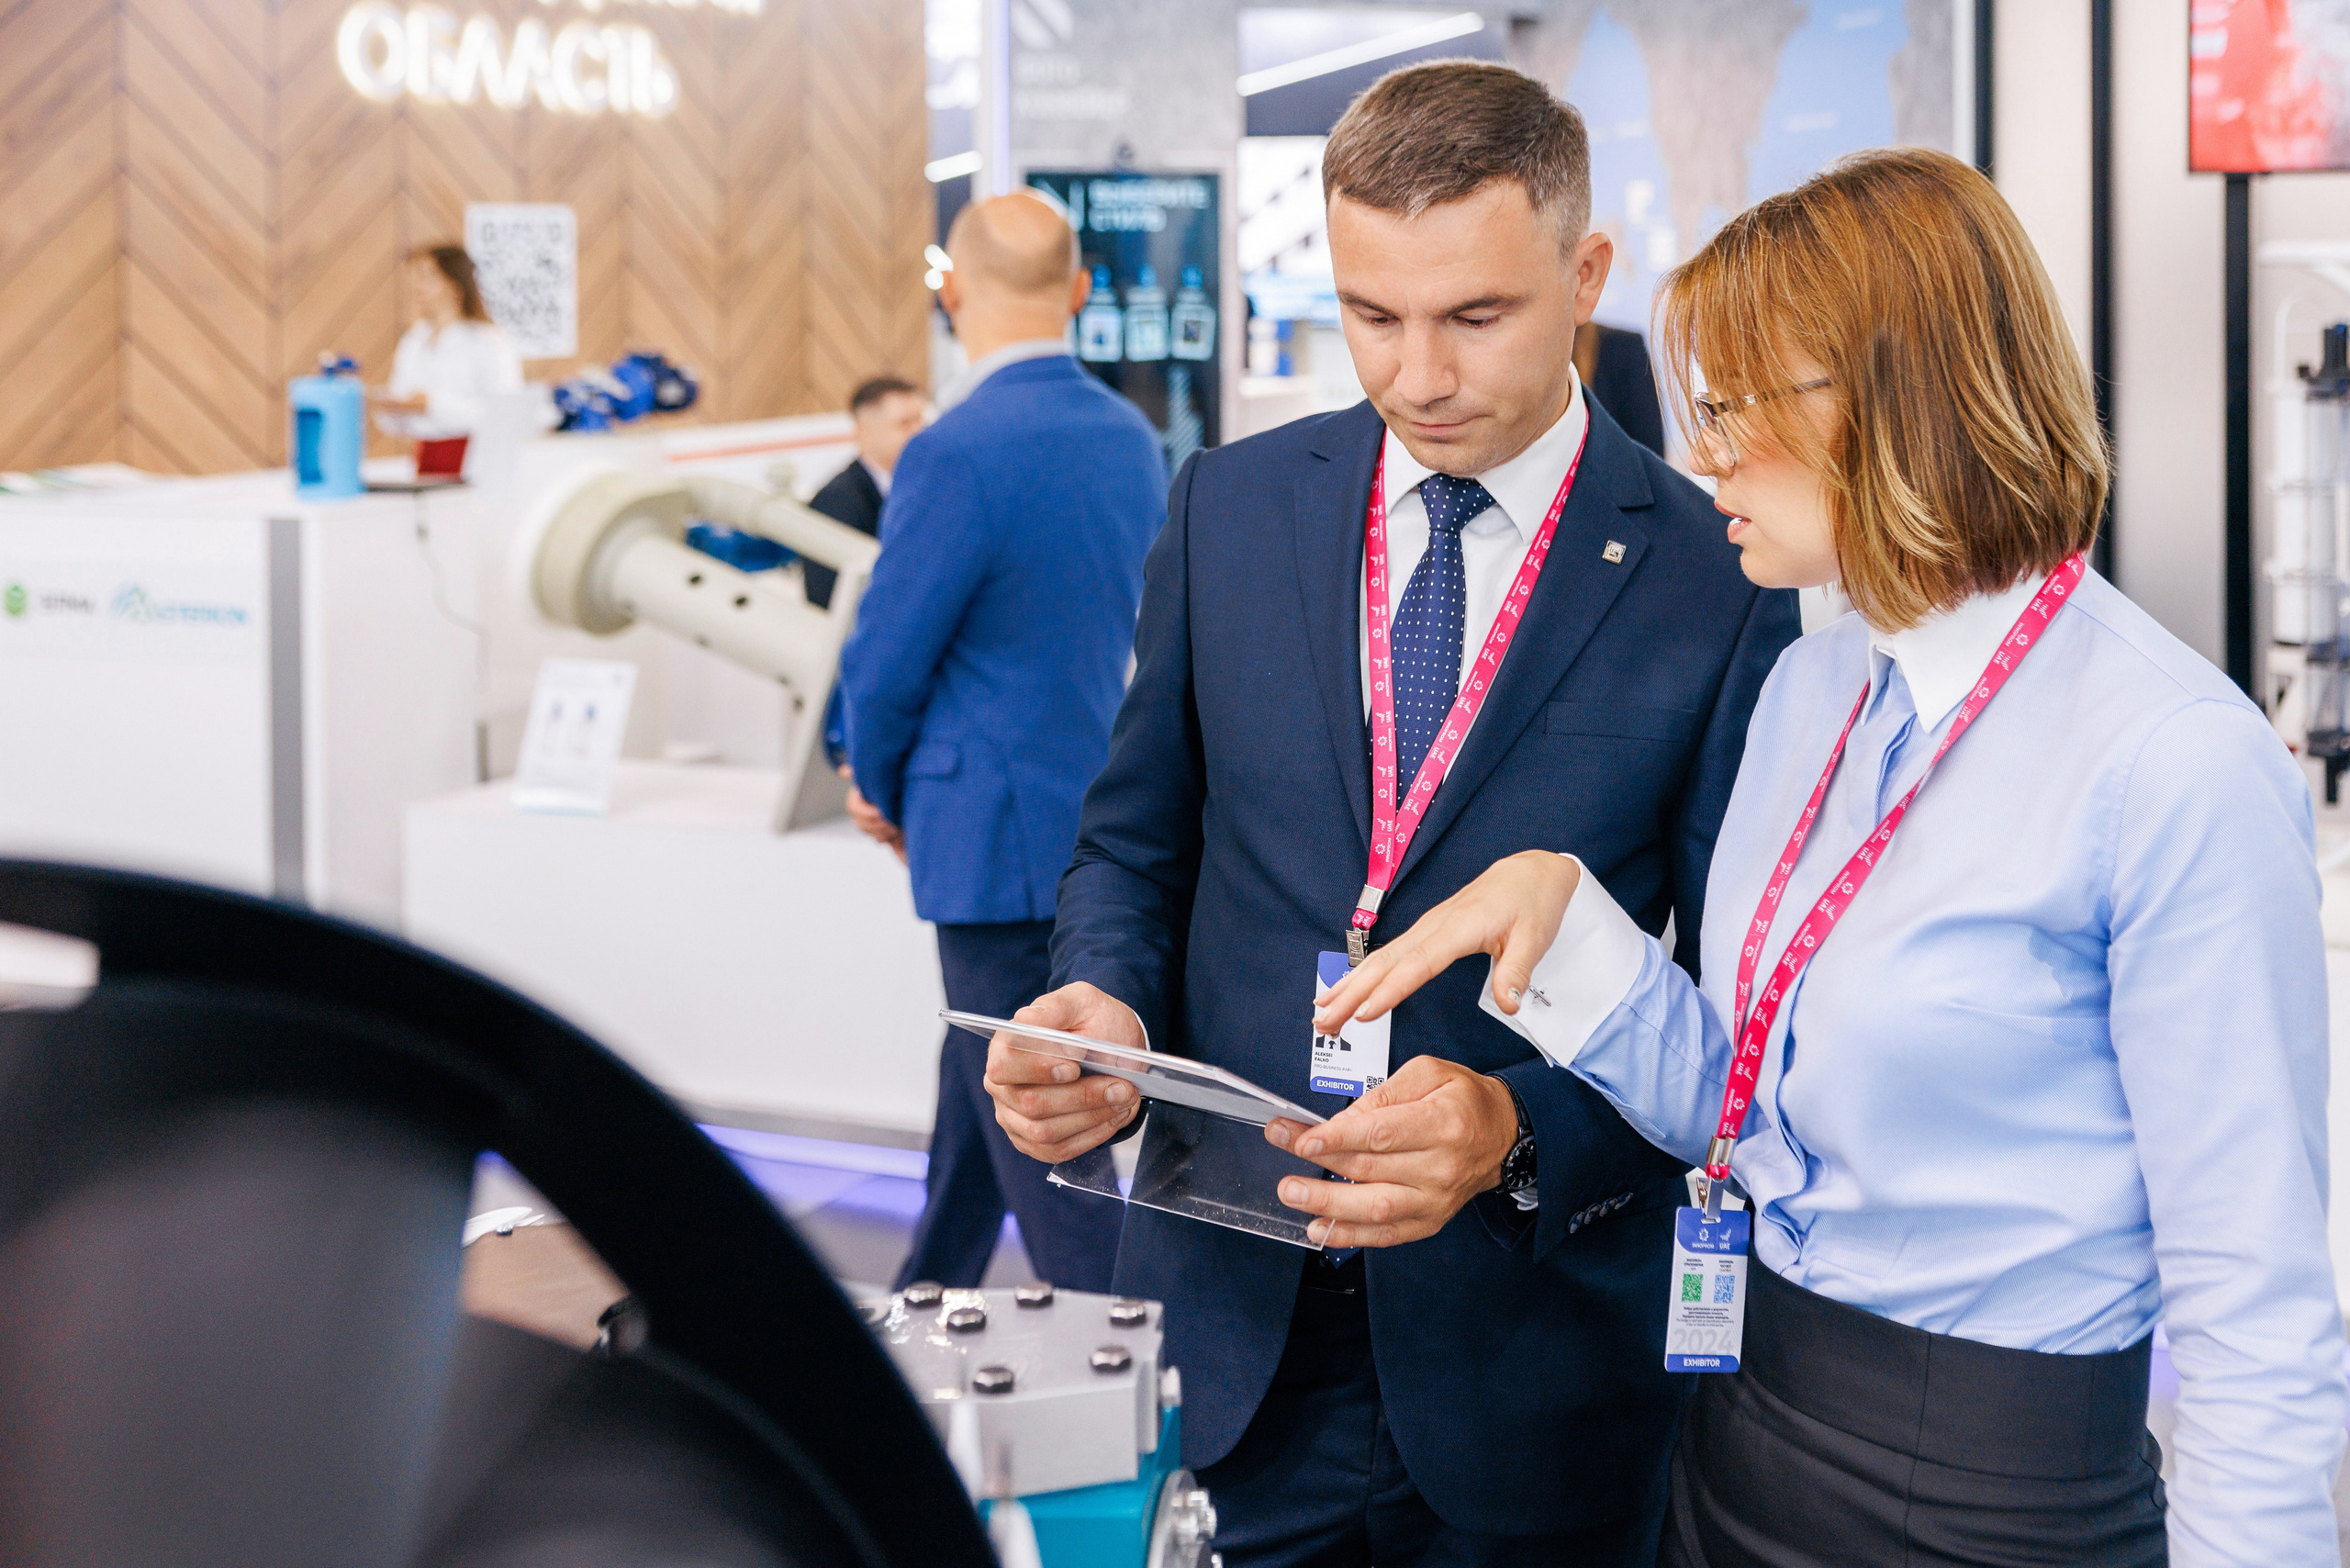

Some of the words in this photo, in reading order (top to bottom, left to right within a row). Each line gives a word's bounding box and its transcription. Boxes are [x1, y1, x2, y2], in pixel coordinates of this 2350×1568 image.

[2031, 598, 2042, 611] UAE
[2005, 622, 2024, 646] INNOPROM
[1993, 651, 2006, 665] UAE
[1969, 677, 1987, 701] INNOPROM
[1959, 706, 1968, 719] UAE
[1859, 847, 1870, 861] UAE
[1830, 870, 1850, 895] INNOPROM
[1818, 898, 1830, 913] UAE
[1761, 920, 1769, 935] UAE
[1793, 923, 1811, 948] INNOPROM
[1783, 951, 1794, 967] UAE
[1762, 977, 1777, 1002] INNOPROM
[1754, 1006, 1762, 1022] UAE
[1741, 1032, 1752, 1058] INNOPROM
[1735, 1061, 1744, 1076] UAE
[1316, 1080, 1354, 1092] EXHIBITOR
[1719, 1242, 1730, 1250] UAE
[1673, 1327, 1733, 1356] 2024
[1684, 1358, 1720, 1368] EXHIBITOR
